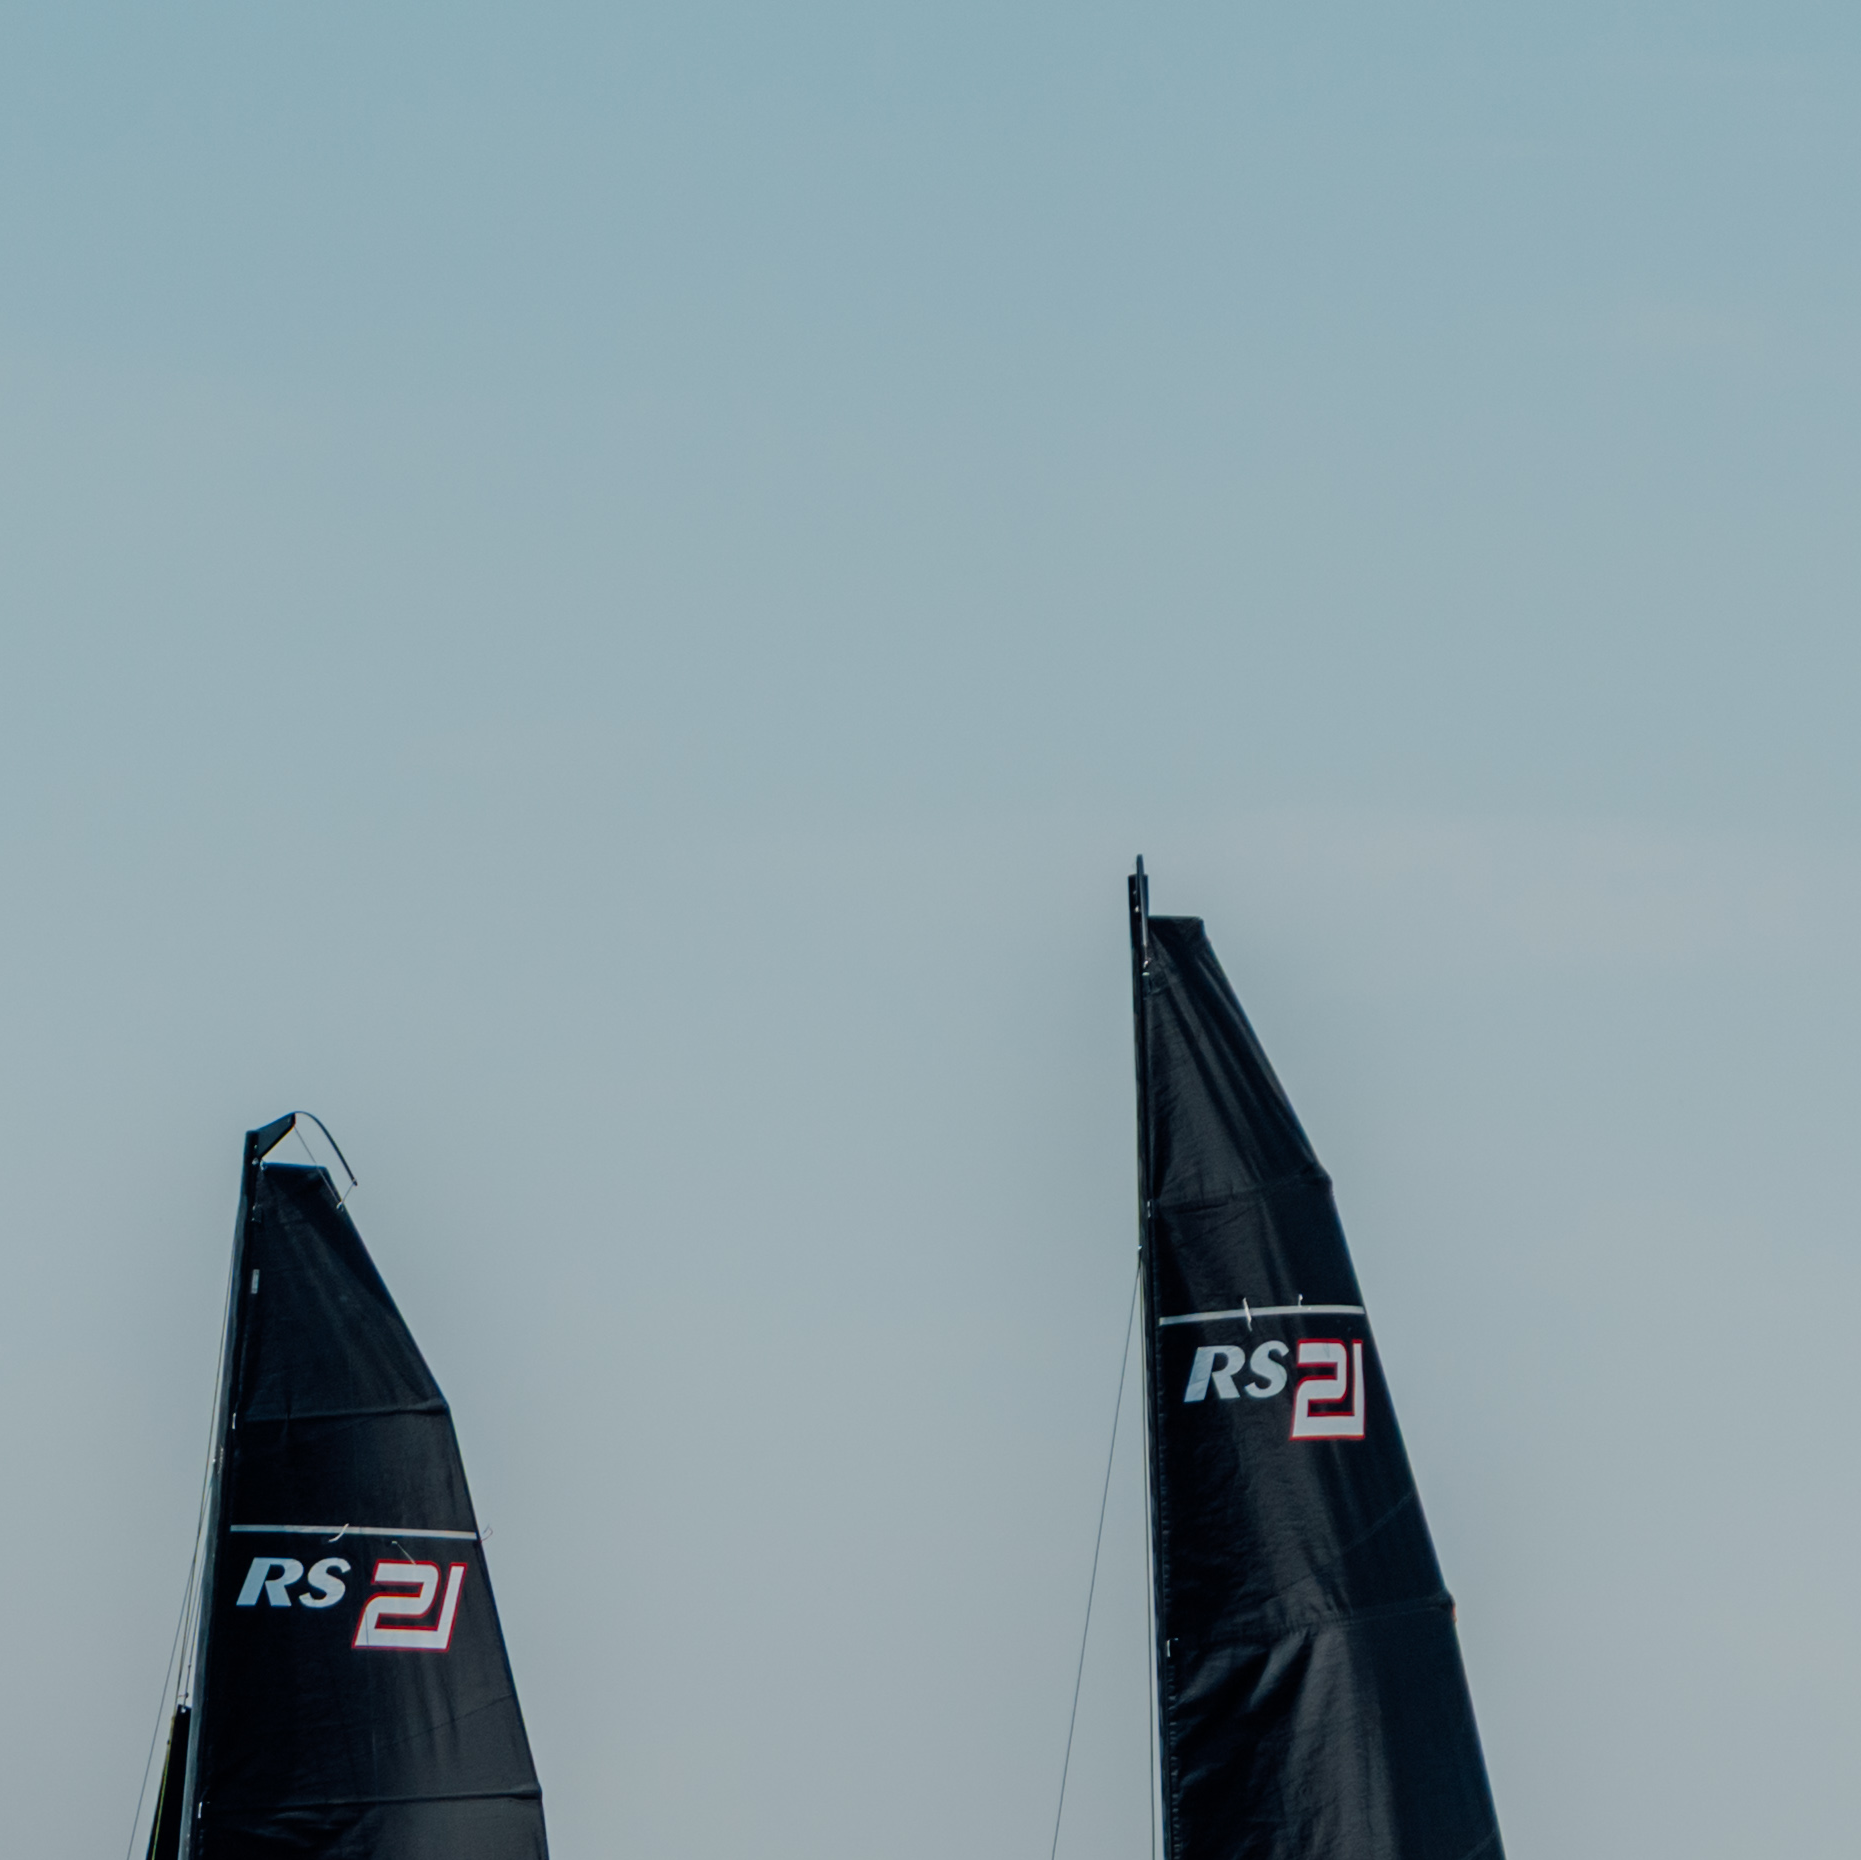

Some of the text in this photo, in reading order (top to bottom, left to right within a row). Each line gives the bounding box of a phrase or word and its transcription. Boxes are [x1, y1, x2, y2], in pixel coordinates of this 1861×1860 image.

[1183, 1338, 1366, 1441] RS 21
[236, 1557, 468, 1653] RS 21
